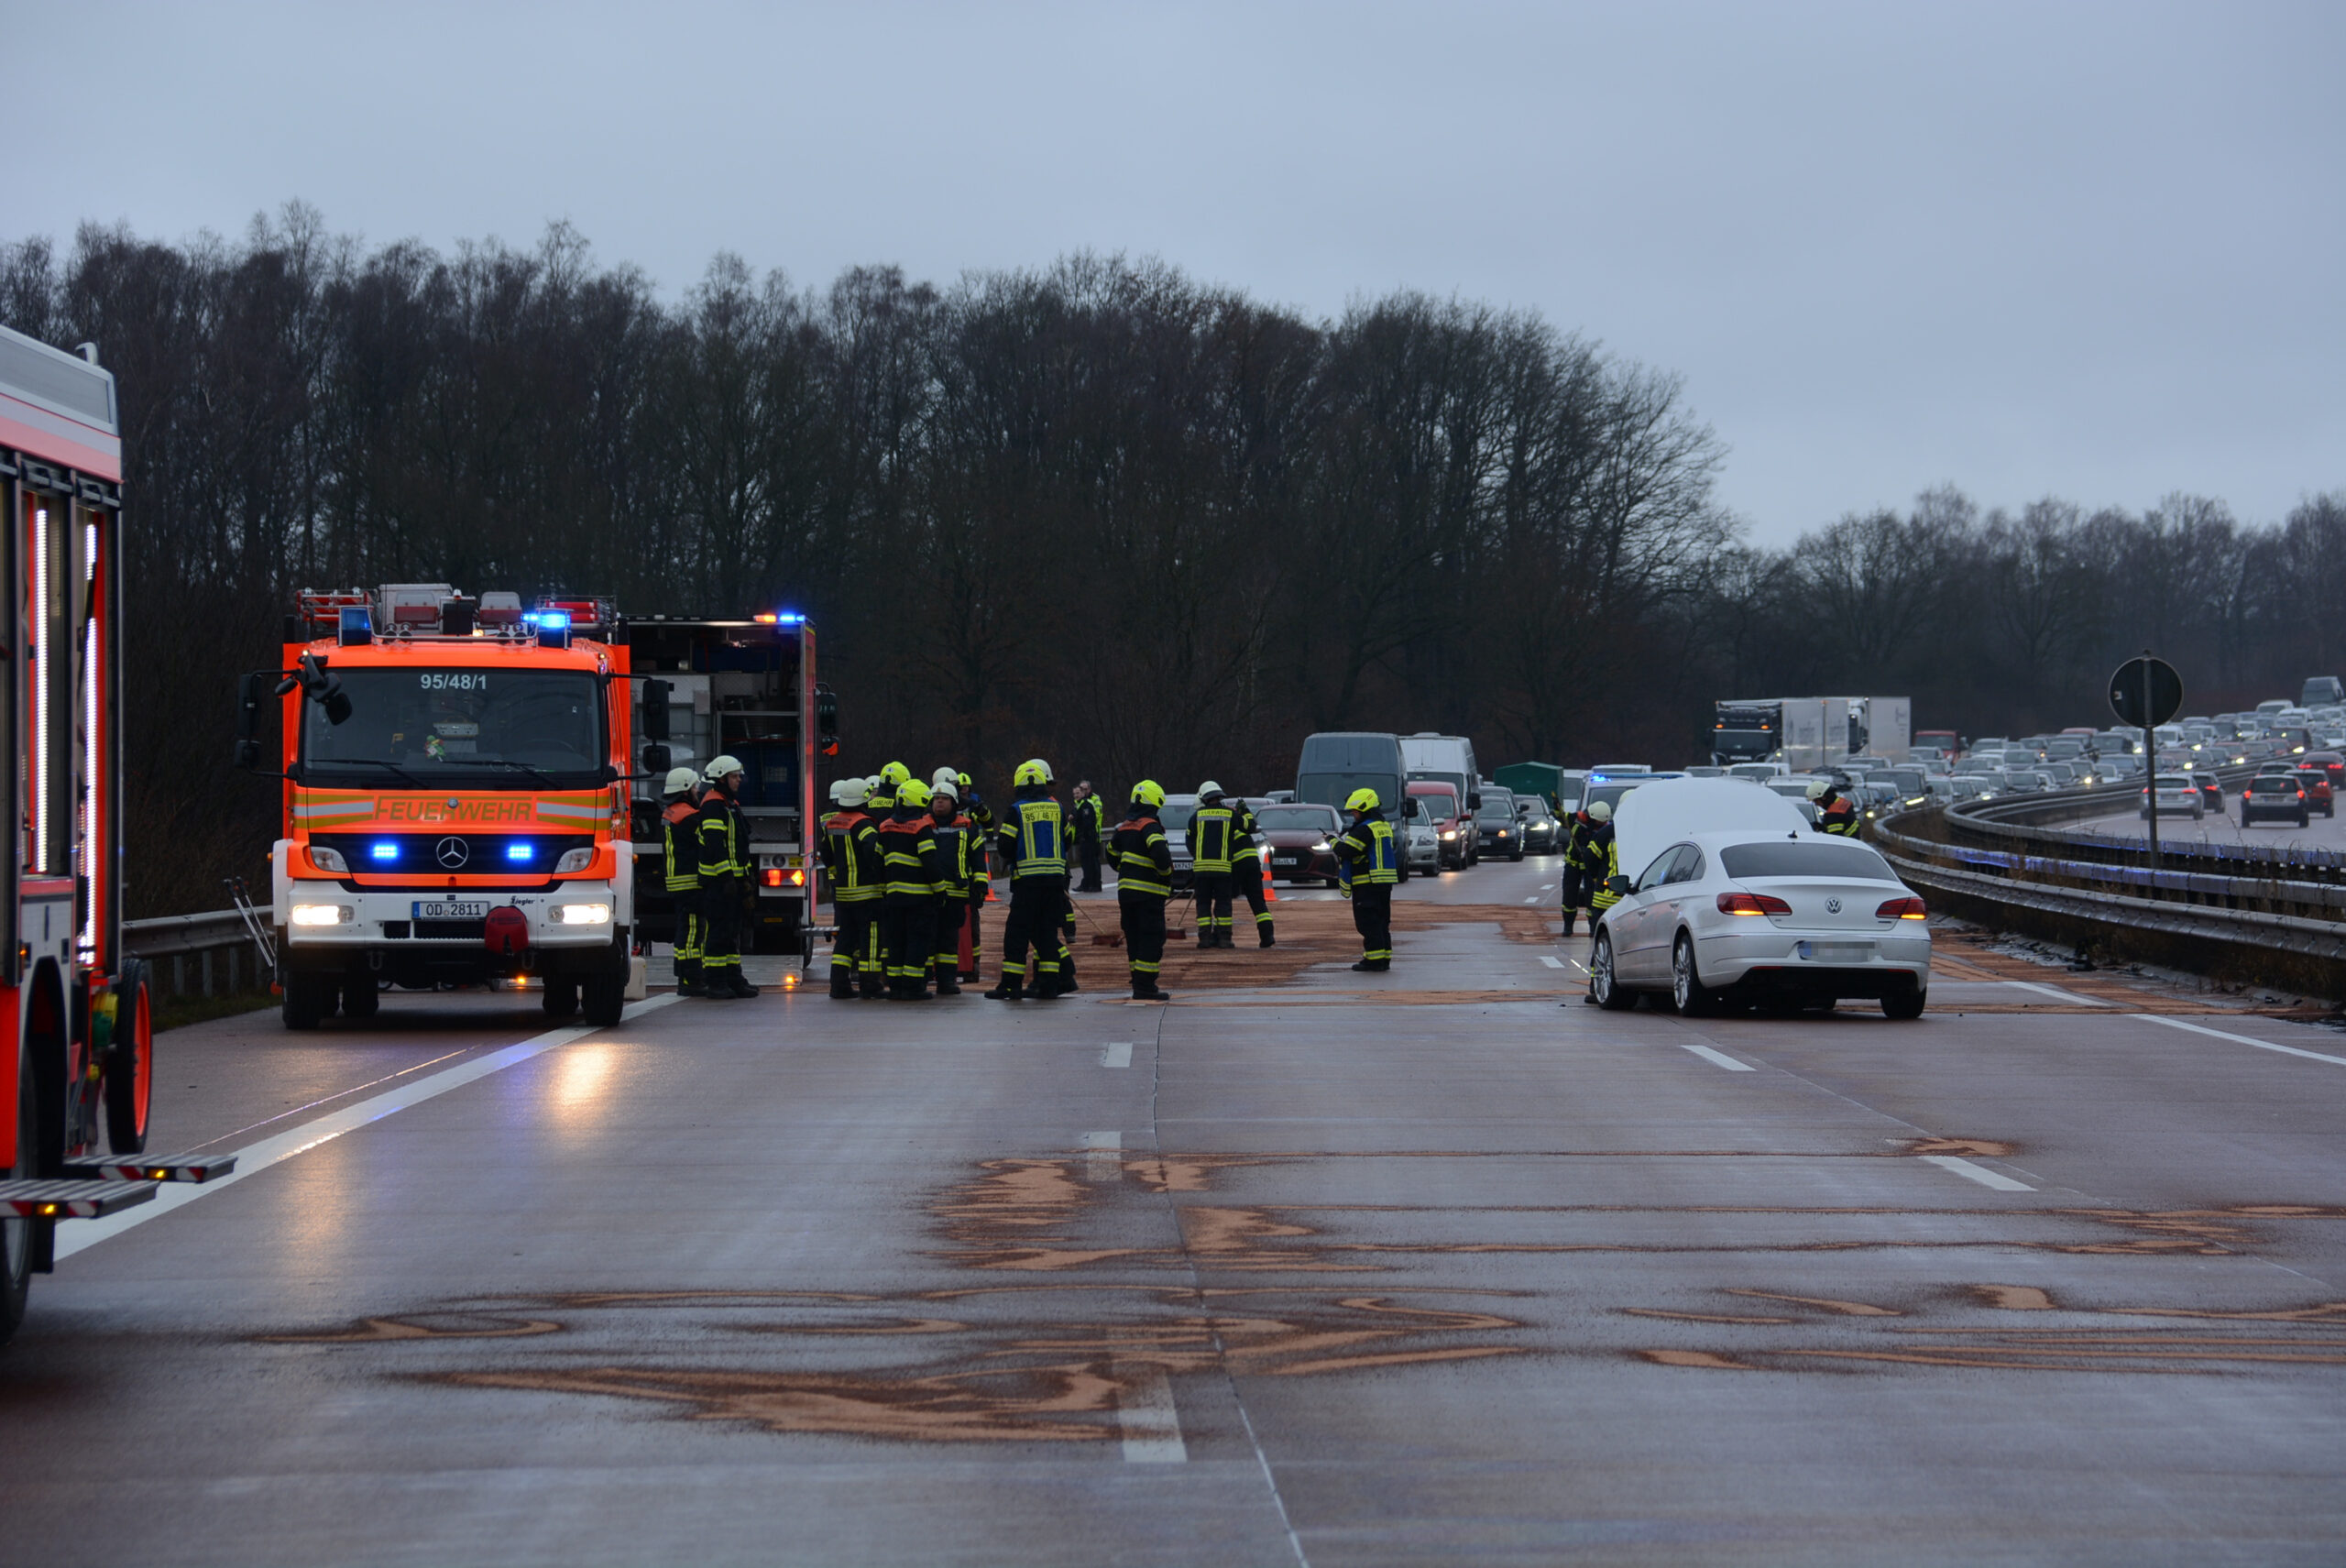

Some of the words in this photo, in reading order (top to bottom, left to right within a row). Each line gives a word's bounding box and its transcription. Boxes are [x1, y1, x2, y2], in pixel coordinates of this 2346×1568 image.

[420, 674, 487, 689] 95/48/1
[375, 795, 532, 821] FEUERWEHR
[426, 904, 443, 916] OD
[450, 904, 482, 916] 2811
